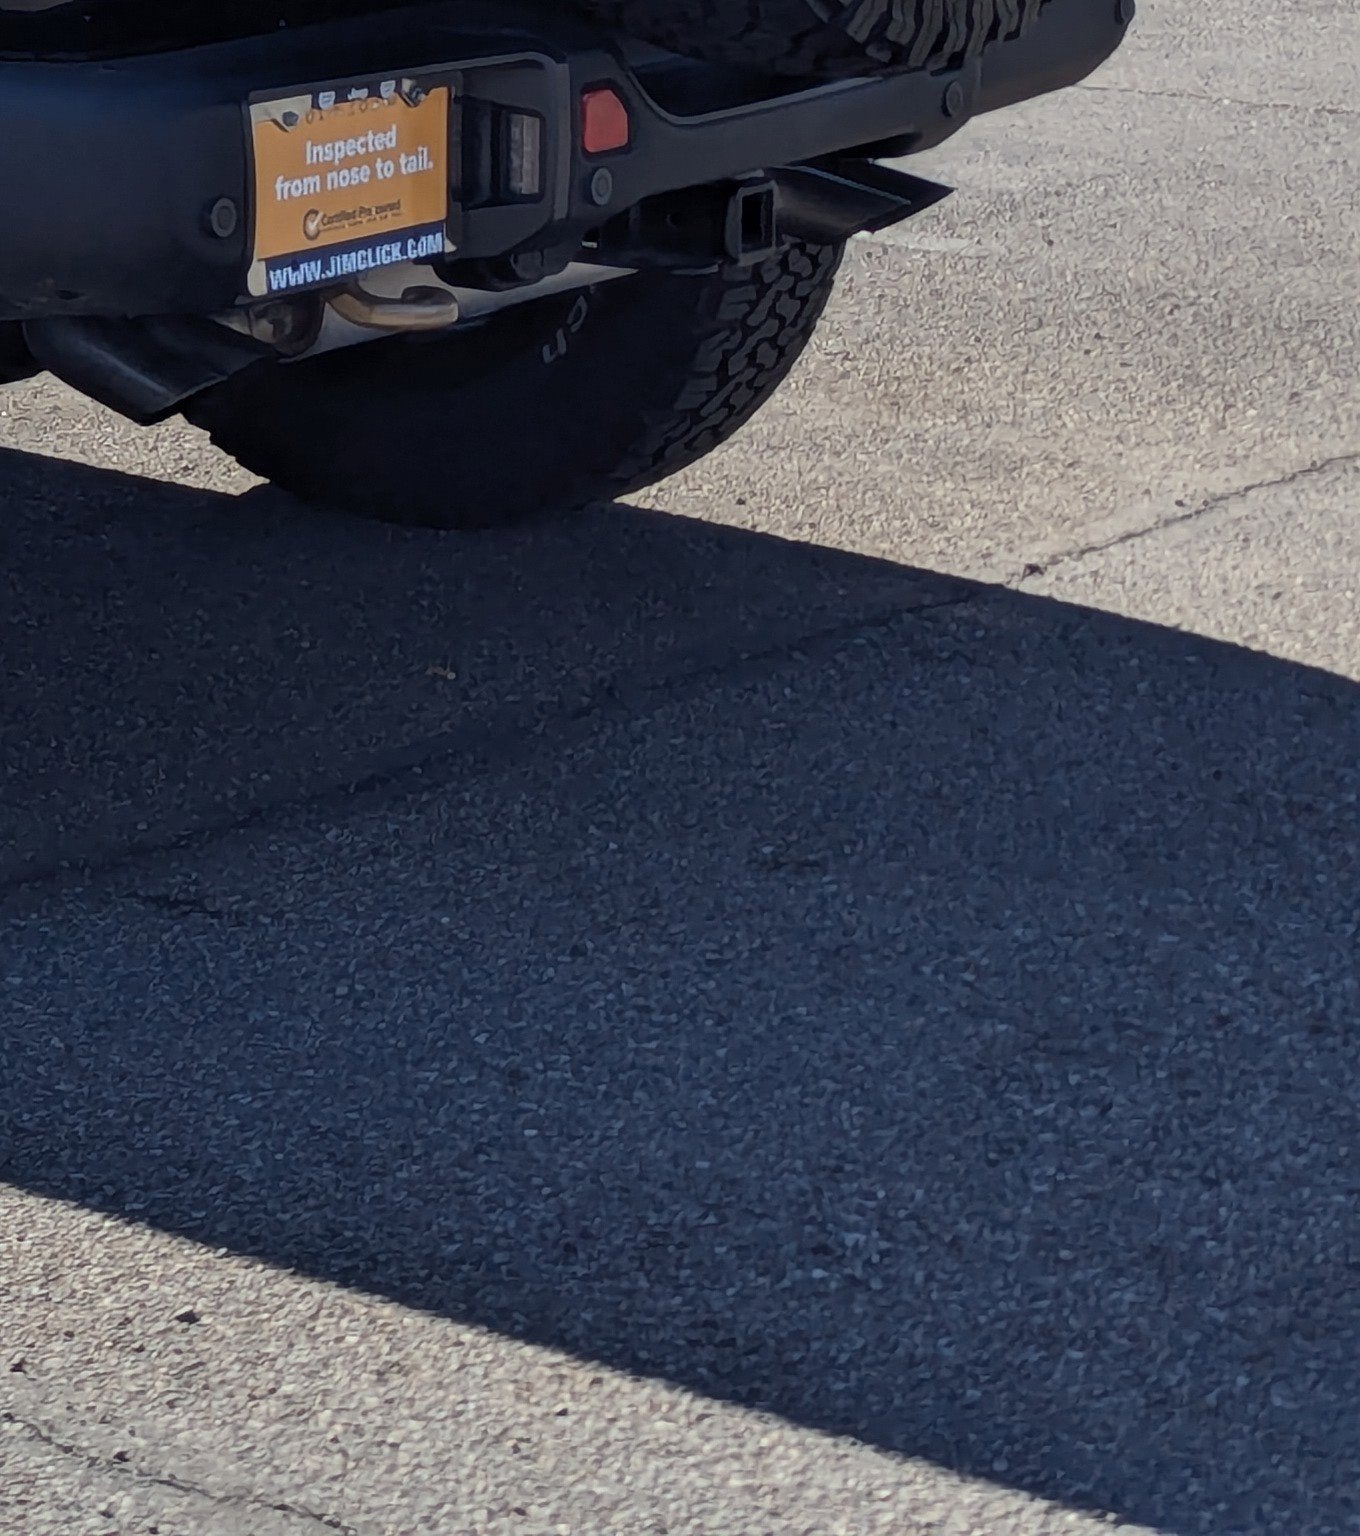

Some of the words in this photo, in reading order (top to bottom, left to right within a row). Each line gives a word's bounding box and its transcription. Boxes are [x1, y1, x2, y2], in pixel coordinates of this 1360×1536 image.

[306, 123, 398, 165] Inspected
[275, 174, 321, 202] from
[326, 164, 371, 191] nose
[375, 157, 394, 180] to
[399, 146, 435, 175] tail.
[269, 232, 443, 291] WWW.JIMCLICK.COM
